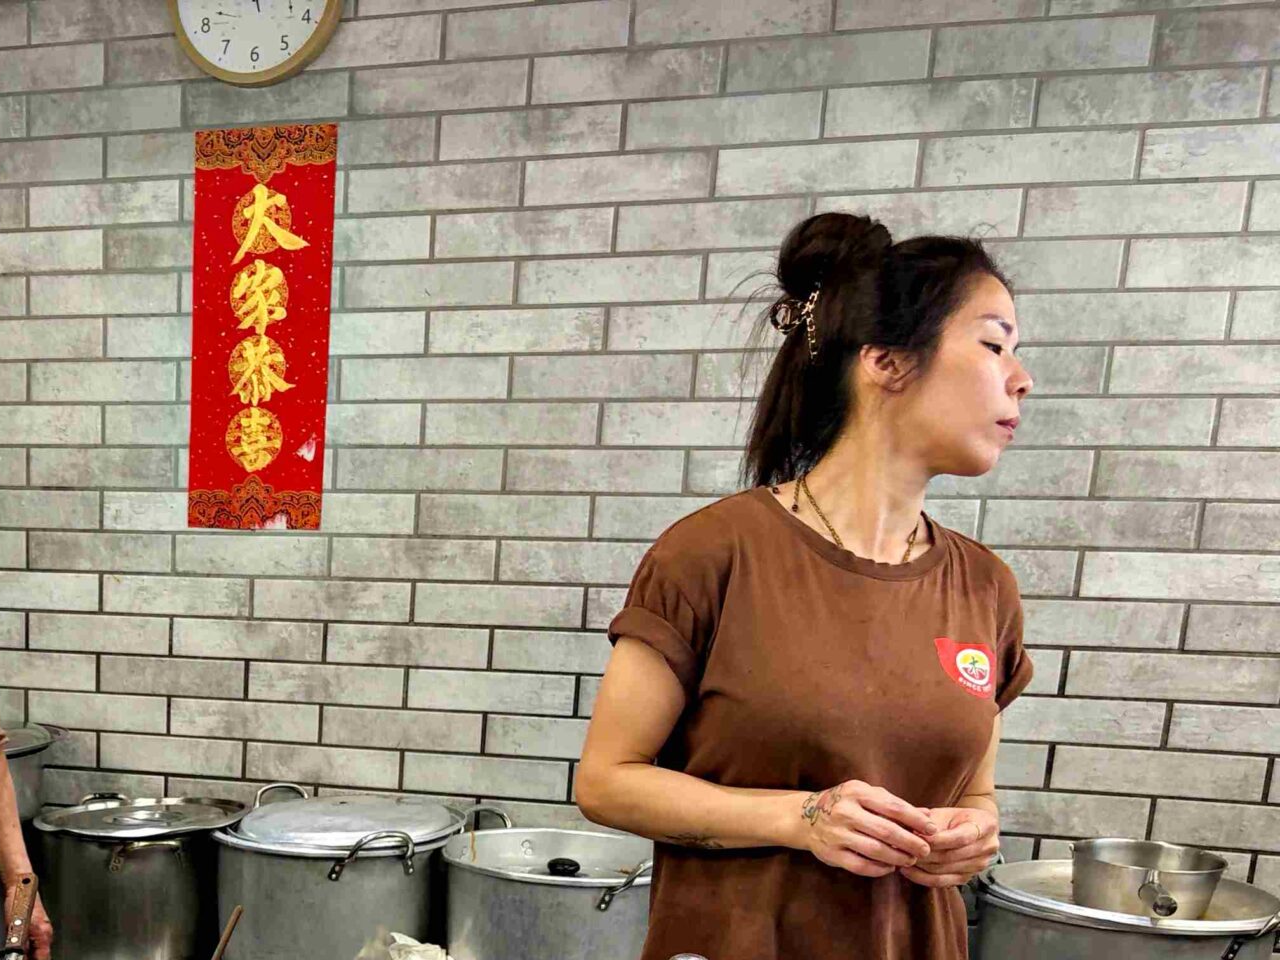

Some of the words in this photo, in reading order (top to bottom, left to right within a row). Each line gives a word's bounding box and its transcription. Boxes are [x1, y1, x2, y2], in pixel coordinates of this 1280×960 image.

[301, 8, 311, 24] 4
[200, 17, 211, 33] 8
[221, 39, 231, 55] 7
[280, 35, 289, 51] 5
[250, 46, 260, 62] 6
[229, 183, 311, 473] 大家恭喜
